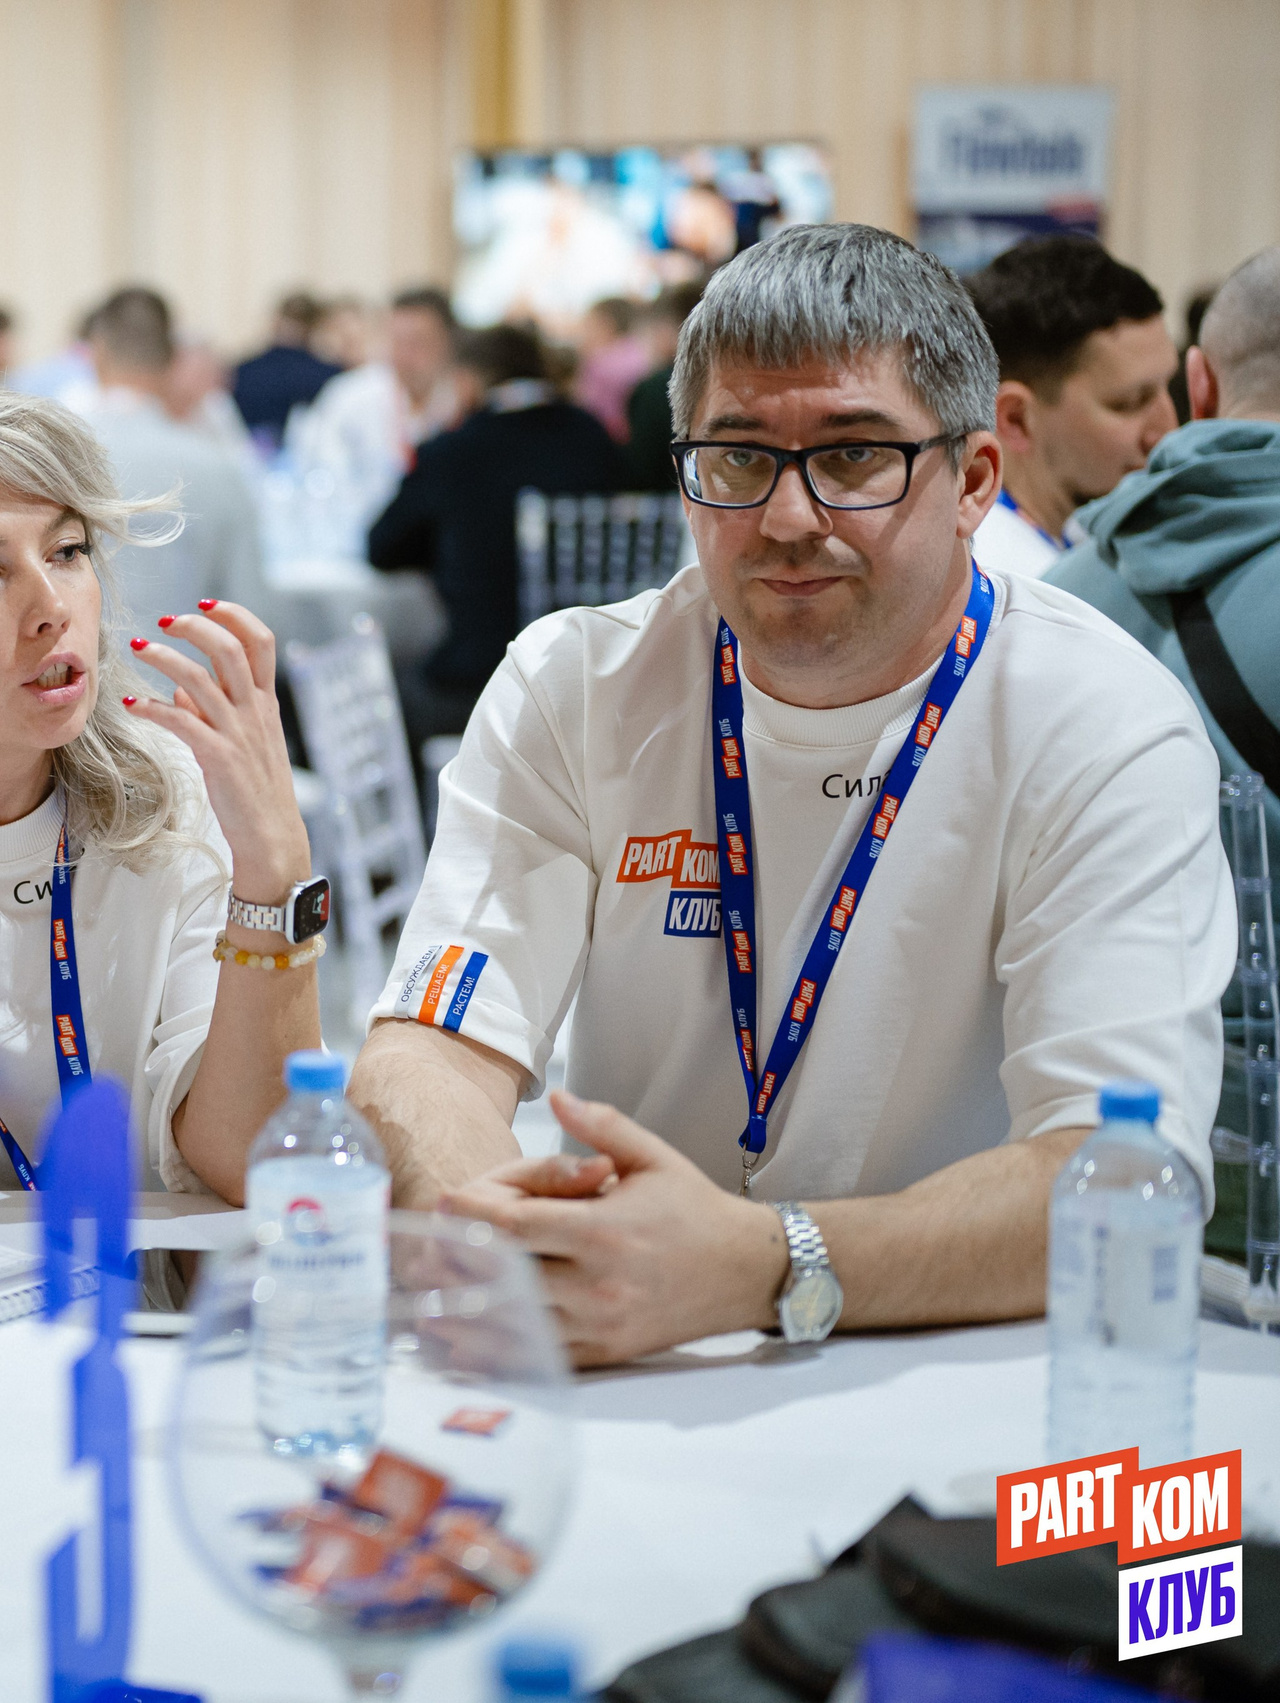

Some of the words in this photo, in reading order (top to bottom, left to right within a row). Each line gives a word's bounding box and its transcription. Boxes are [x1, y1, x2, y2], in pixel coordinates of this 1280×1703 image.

[721, 627, 729, 646] КЛУБ
[963, 617, 975, 641] PART
[723, 646, 734, 664] KOM
[957, 634, 969, 656] KOM
[723, 663, 735, 684] PART
[953, 656, 967, 678] КЛУБ
[927, 704, 941, 728] PART
[719, 718, 733, 738] КЛУБ
[916, 724, 931, 746] KOM
[724, 738, 739, 757] KOM
[724, 756, 740, 777] PART
[821, 771, 892, 799] Сил
[882, 796, 898, 820] PART
[723, 813, 738, 832] КЛУБ
[874, 815, 888, 837] KOM
[729, 834, 744, 853] KOM
[623, 835, 683, 876] PART
[679, 848, 721, 884] KOM
[730, 853, 746, 874] PART
[841, 888, 855, 913] PART
[668, 897, 722, 932] КЛУБ
[729, 910, 744, 930] КЛУБ
[832, 907, 846, 930] KOM
[55, 920, 66, 940] PART
[828, 929, 841, 952] КЛУБ
[54, 941, 66, 959] KOM
[735, 932, 749, 950] KOM
[58, 960, 72, 980] КЛУБ
[736, 950, 750, 971] PART
[401, 948, 435, 1003] ОБСУЖДАЕМ
[427, 963, 450, 1005] РЕШАЕМ!
[452, 976, 476, 1016] РАСТЕМ!
[801, 980, 815, 1004] PART
[736, 1008, 748, 1028] КЛУБ
[792, 1000, 806, 1021] KOM
[57, 1016, 74, 1036] PART
[788, 1021, 801, 1042] КЛУБ
[59, 1036, 77, 1054] KOM
[67, 1056, 84, 1076] КЛУБ
[763, 1074, 775, 1094] PART
[757, 1093, 767, 1112] KOM
[18, 1162, 32, 1182] КЛУБ
